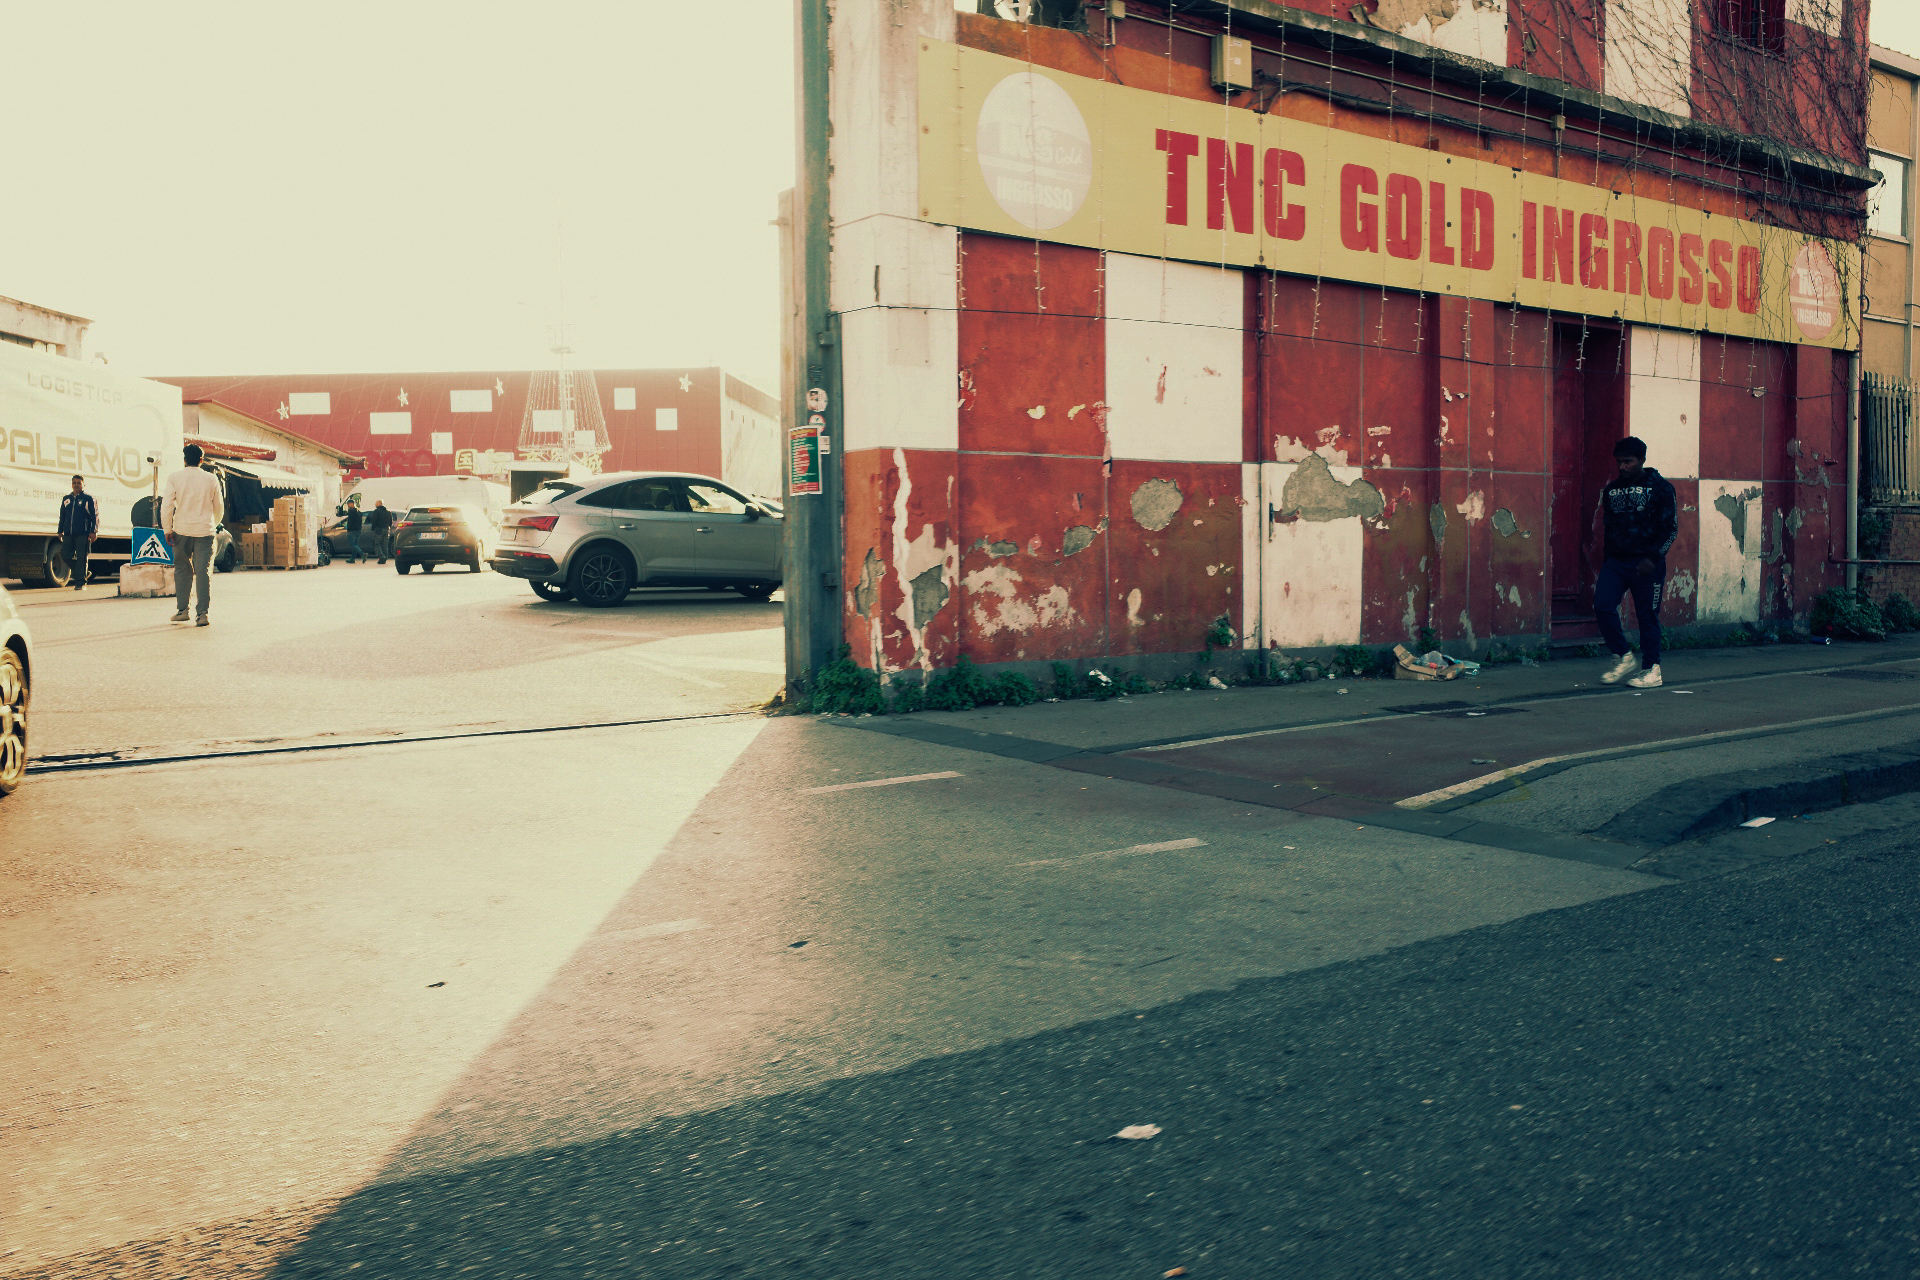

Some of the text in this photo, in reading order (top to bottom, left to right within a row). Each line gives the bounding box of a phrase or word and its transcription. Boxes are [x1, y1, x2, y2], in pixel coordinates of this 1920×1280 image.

[996, 176, 1073, 212] INGROSSO
[1156, 129, 1761, 315] TNC GOLD INGROSSO
[1797, 307, 1831, 328] INGROSSO
[28, 371, 123, 406] LOGISTICA
[1609, 486, 1653, 497] GHOST
